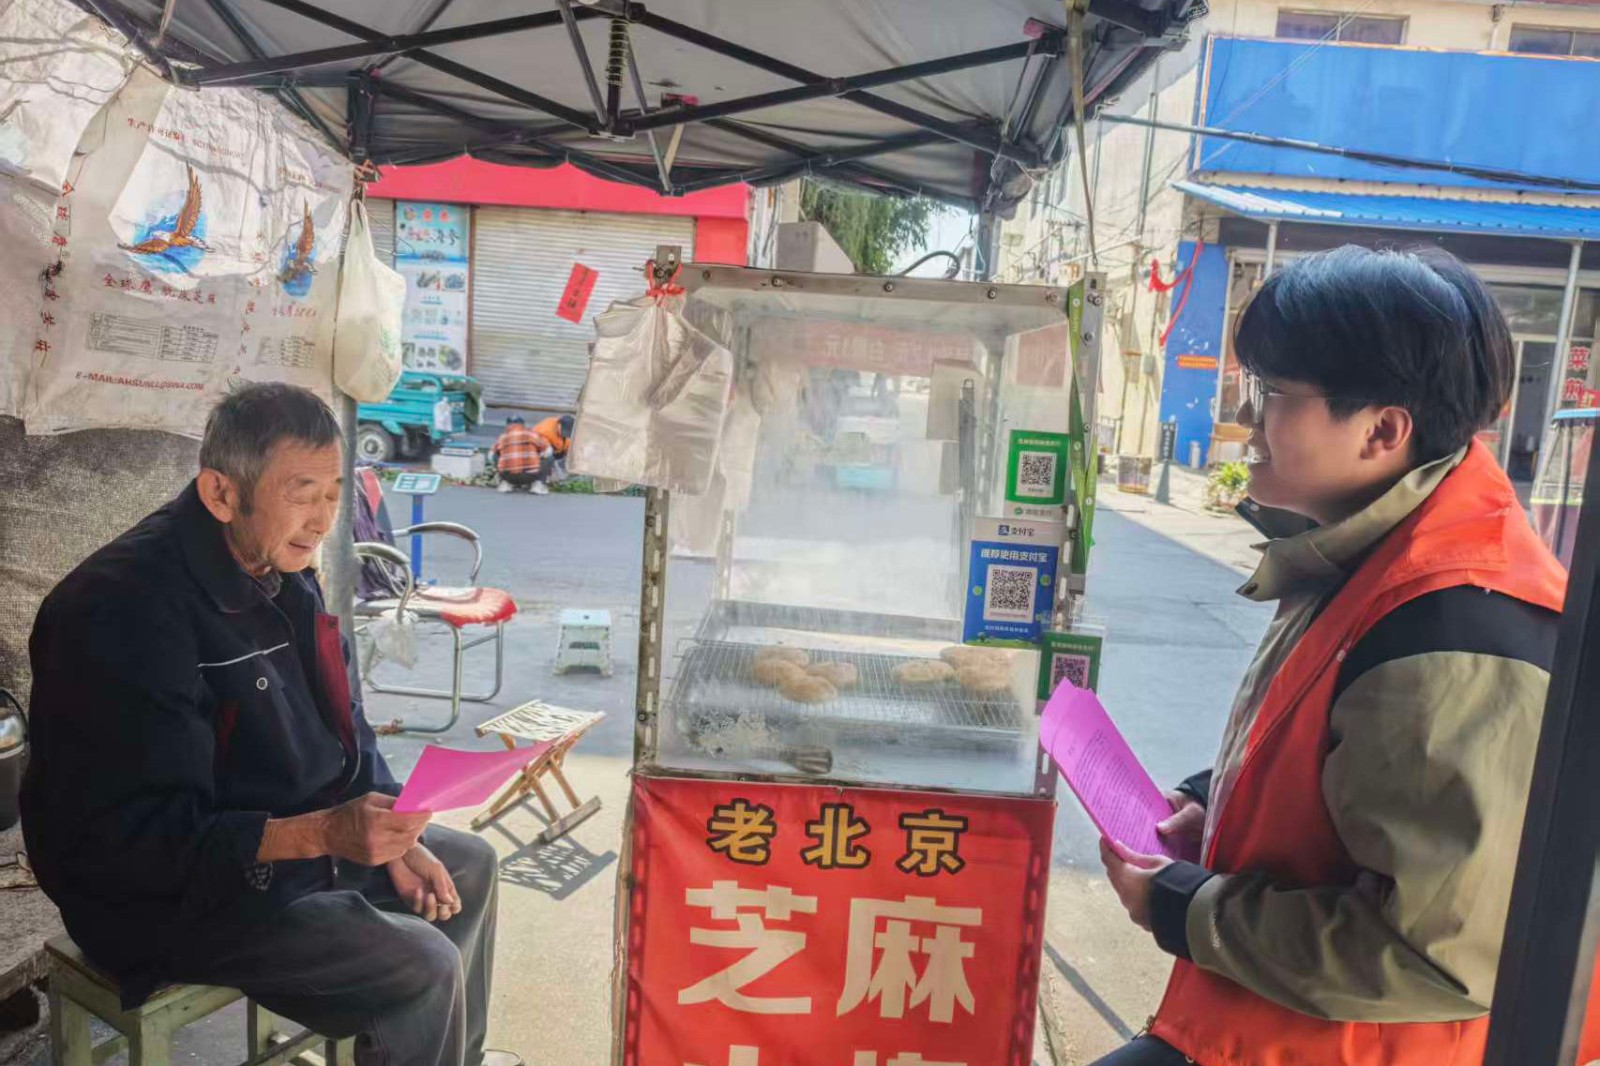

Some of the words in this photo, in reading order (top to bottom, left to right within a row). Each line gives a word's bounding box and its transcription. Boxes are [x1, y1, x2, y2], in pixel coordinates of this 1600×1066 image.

[1010, 526, 1035, 537] 支付宝
[981, 548, 1048, 563] 推荐使用支付宝
[706, 797, 968, 876] 老北京
[677, 879, 983, 1023] 芝麻
